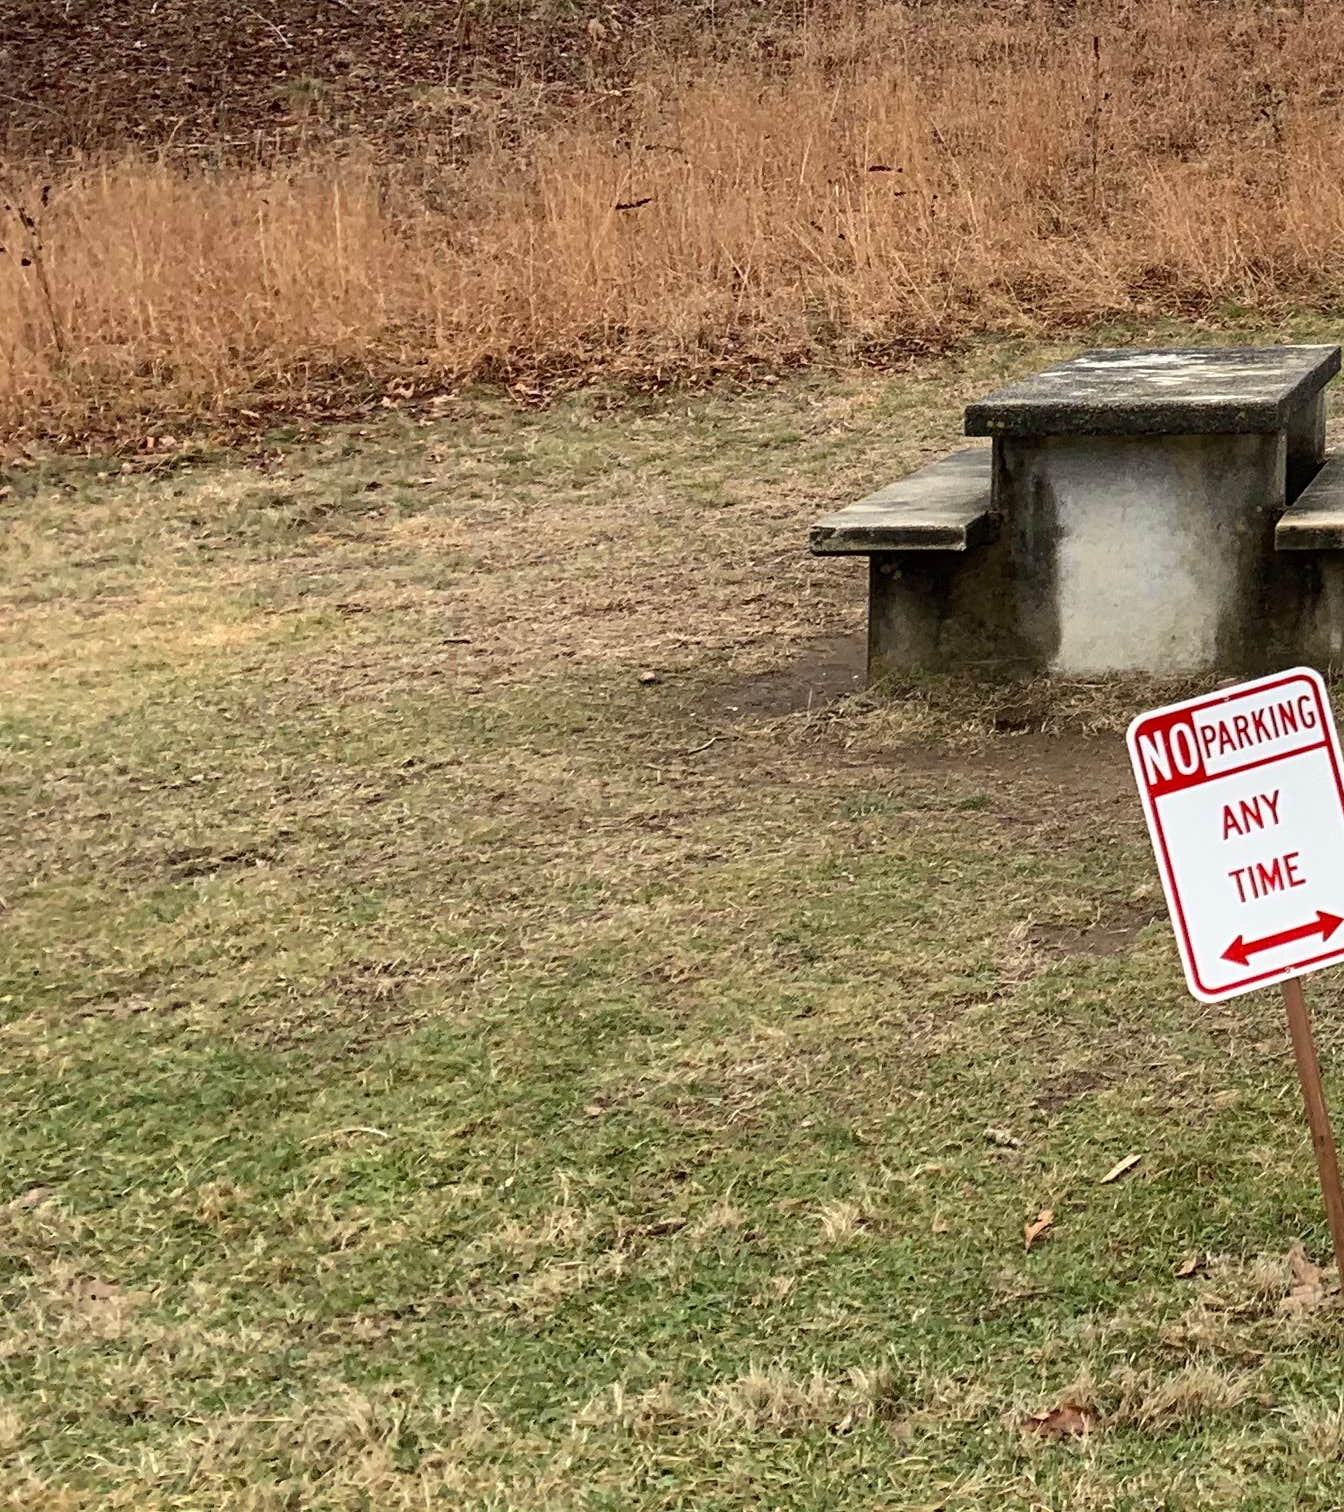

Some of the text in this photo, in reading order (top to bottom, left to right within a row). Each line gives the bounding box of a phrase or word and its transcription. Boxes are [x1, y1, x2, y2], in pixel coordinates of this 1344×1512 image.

[1139, 695, 1316, 785] NO PARKING
[1222, 790, 1280, 840] ANY
[1228, 852, 1306, 903] TIME
